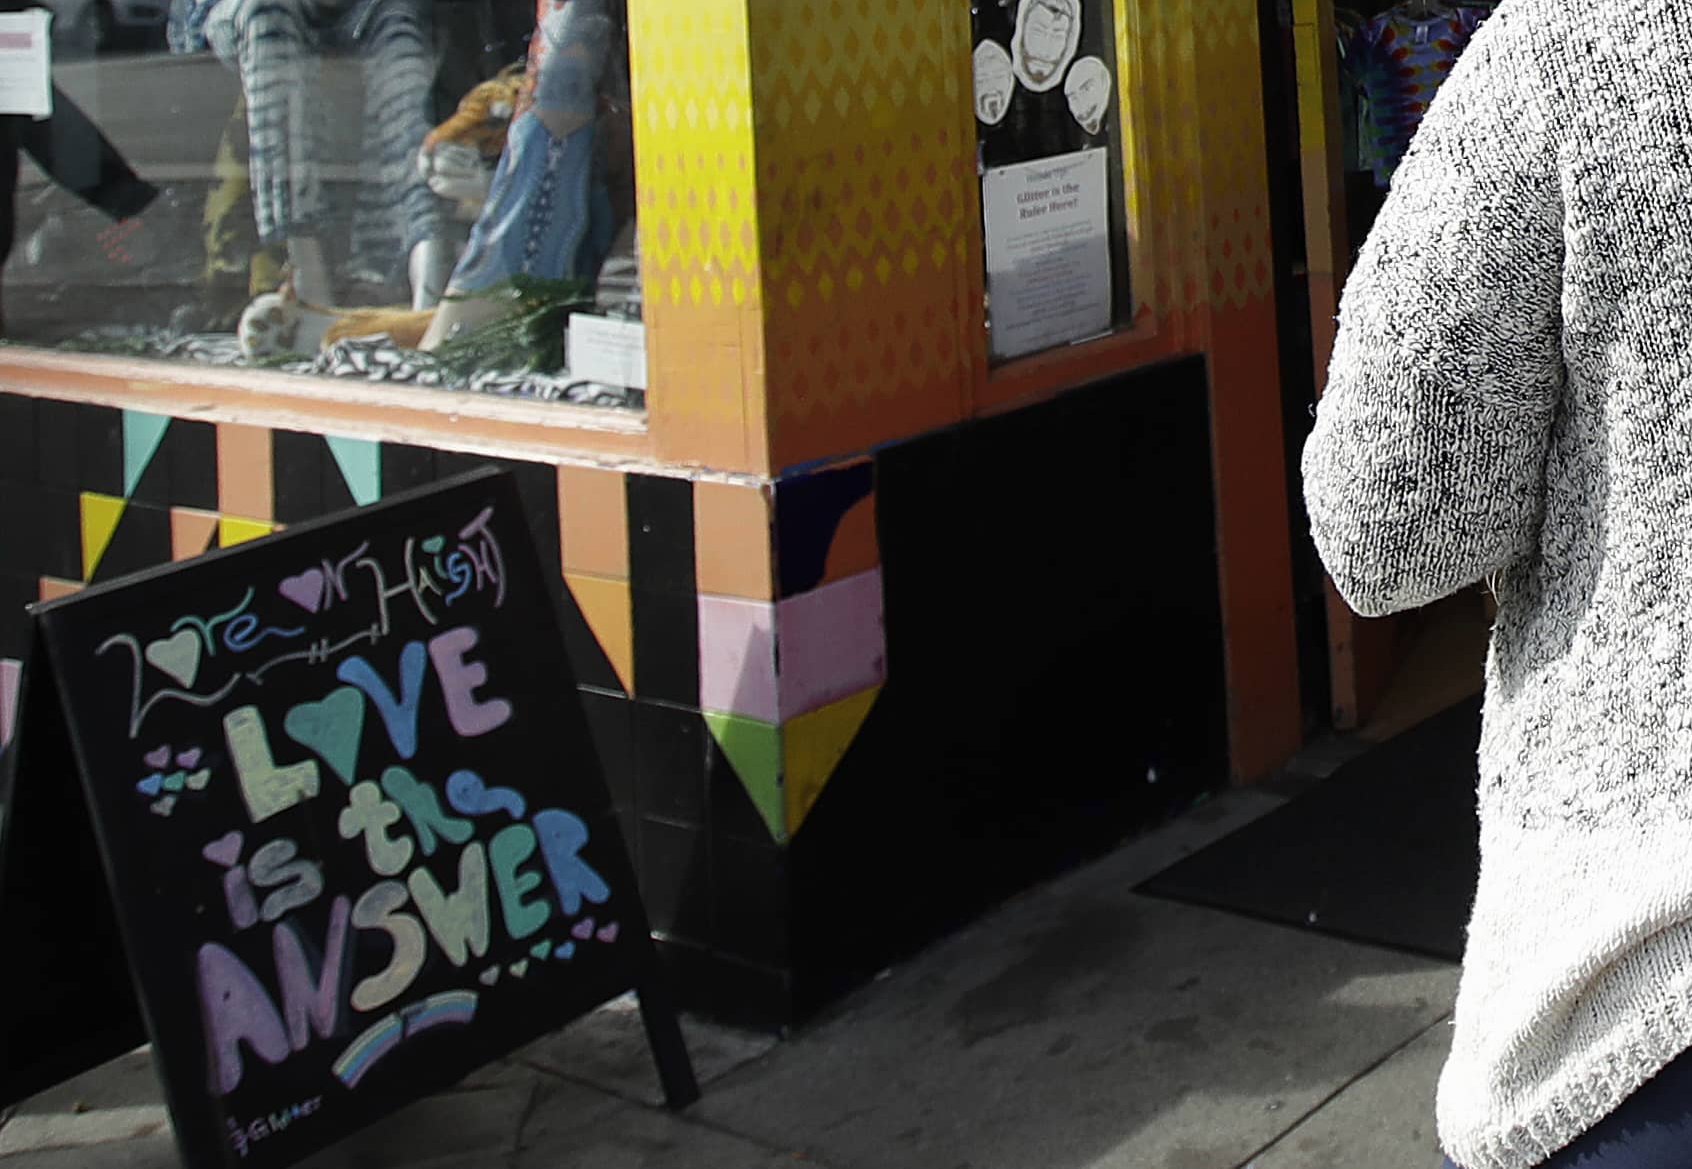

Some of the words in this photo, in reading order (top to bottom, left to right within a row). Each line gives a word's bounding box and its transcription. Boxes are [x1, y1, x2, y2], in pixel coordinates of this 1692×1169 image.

[1062, 182, 1080, 194] the
[222, 627, 513, 823] LOVE
[198, 808, 611, 1095] ANSWER
